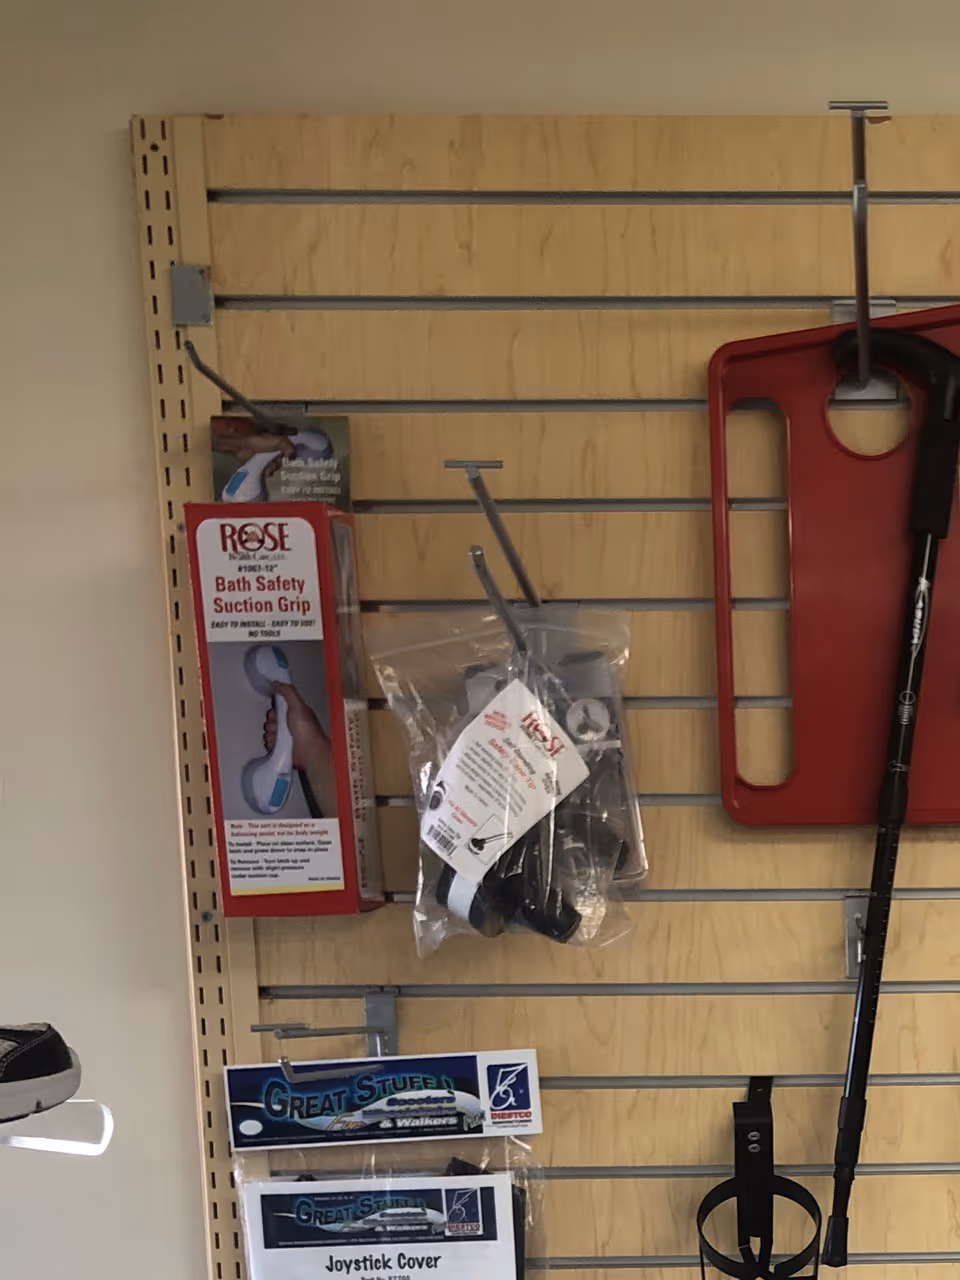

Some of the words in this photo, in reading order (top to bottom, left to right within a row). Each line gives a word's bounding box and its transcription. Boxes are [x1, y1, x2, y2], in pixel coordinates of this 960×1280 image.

[220, 522, 291, 553] ROSE
[215, 576, 251, 593] Bath
[256, 575, 305, 594] Safety
[213, 597, 273, 614] Suction
[278, 597, 311, 616] Grip
[325, 1253, 392, 1275] Joystick
[398, 1252, 441, 1270] Cover
